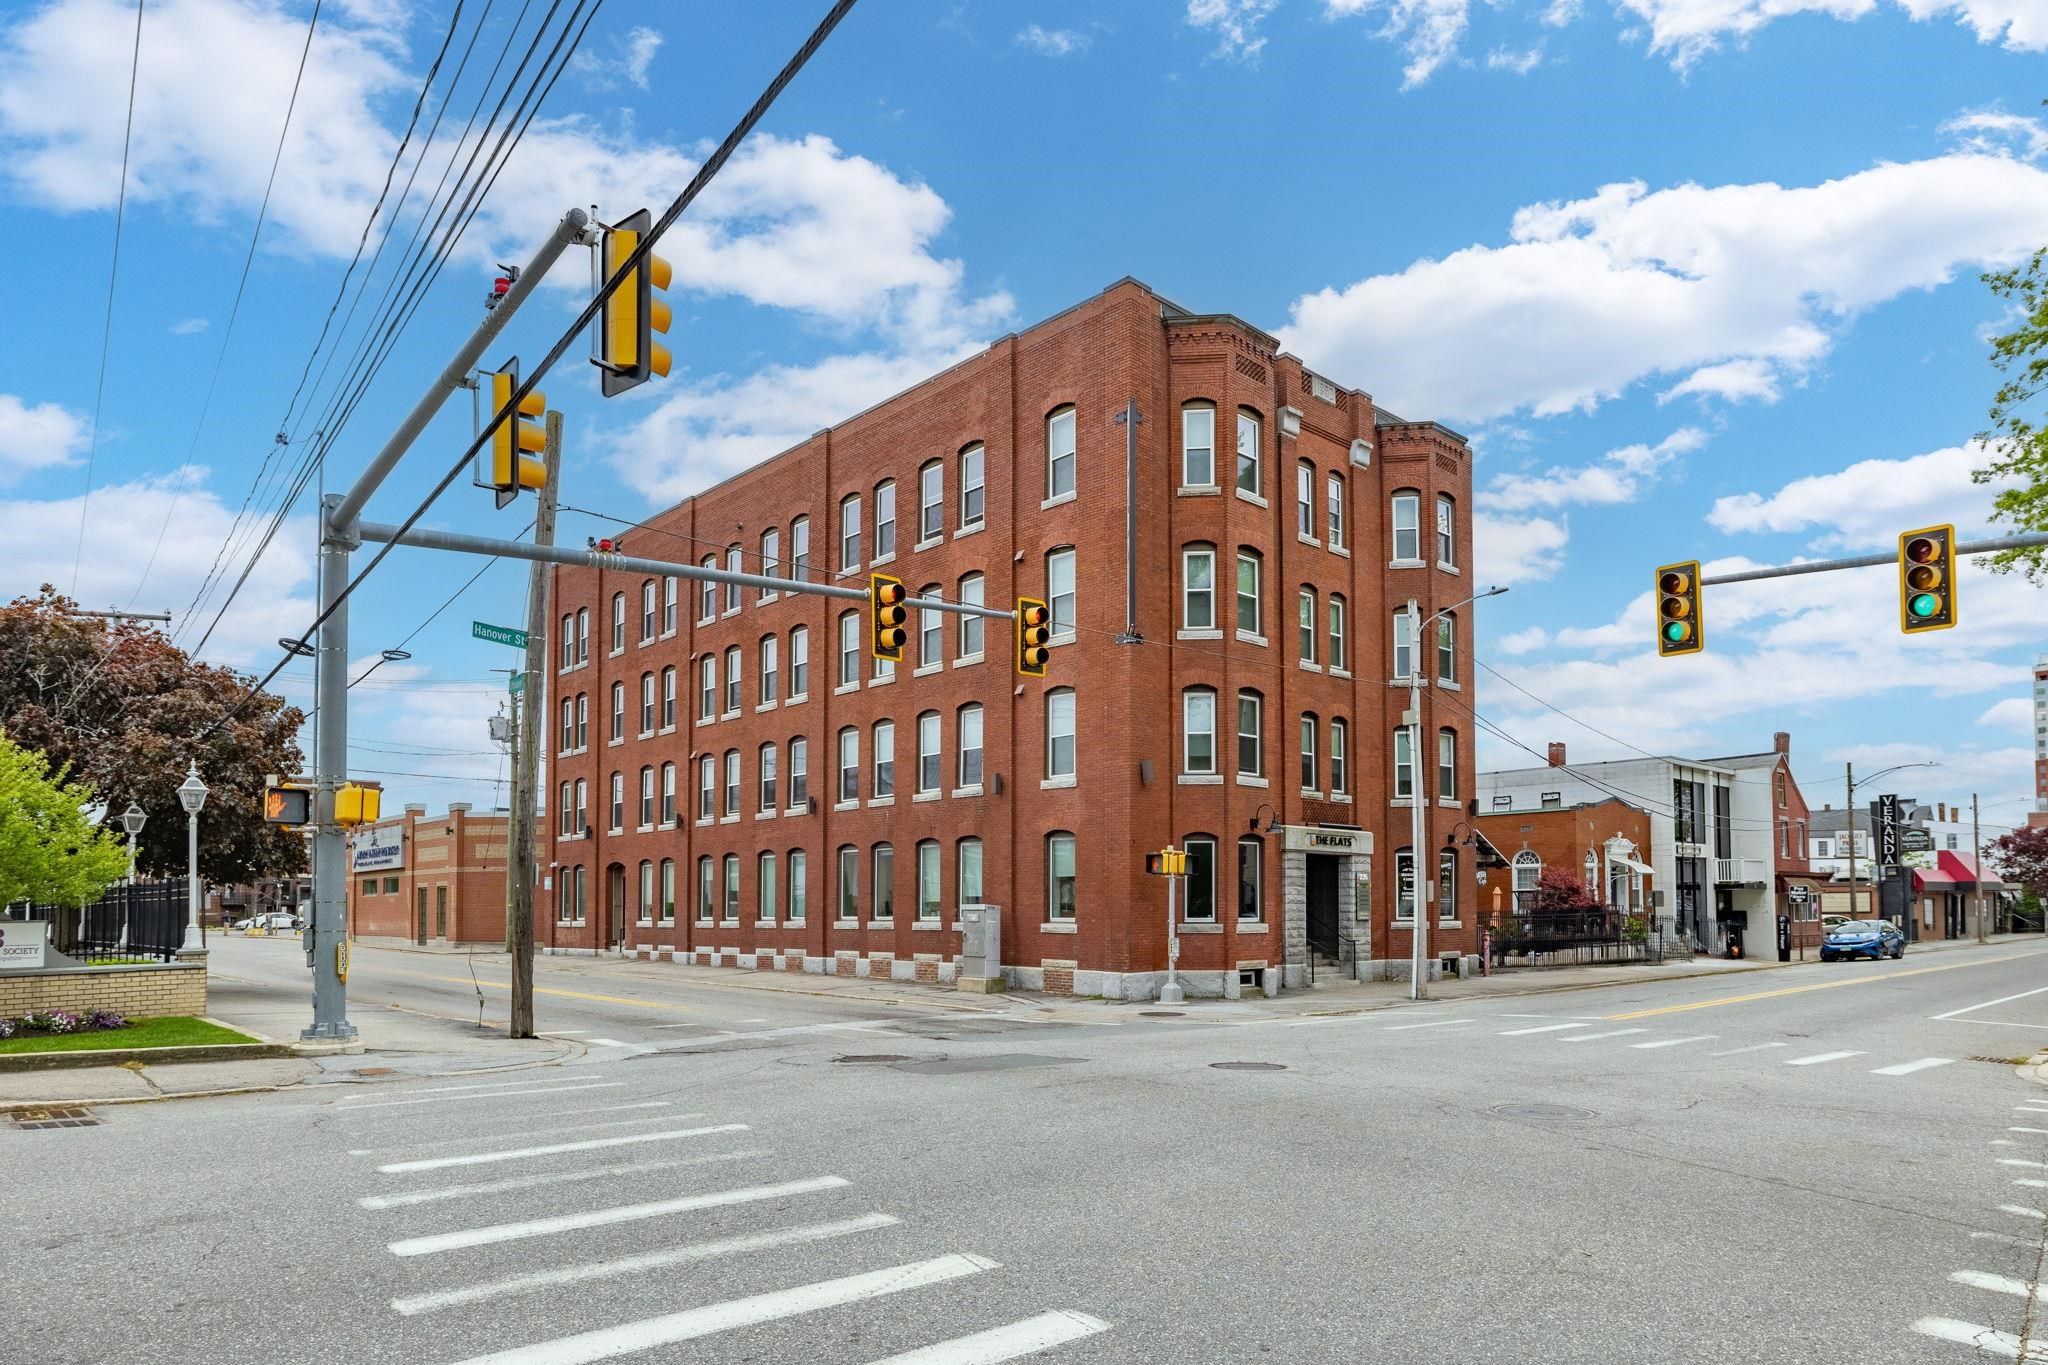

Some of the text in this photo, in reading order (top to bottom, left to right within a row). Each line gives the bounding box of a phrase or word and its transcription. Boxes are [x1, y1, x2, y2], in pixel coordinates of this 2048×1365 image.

[474, 624, 525, 646] Hanover St
[1882, 796, 1895, 864] VERANDA
[1316, 835, 1352, 847] THE FLATS
[3, 947, 39, 956] SOCIETY
